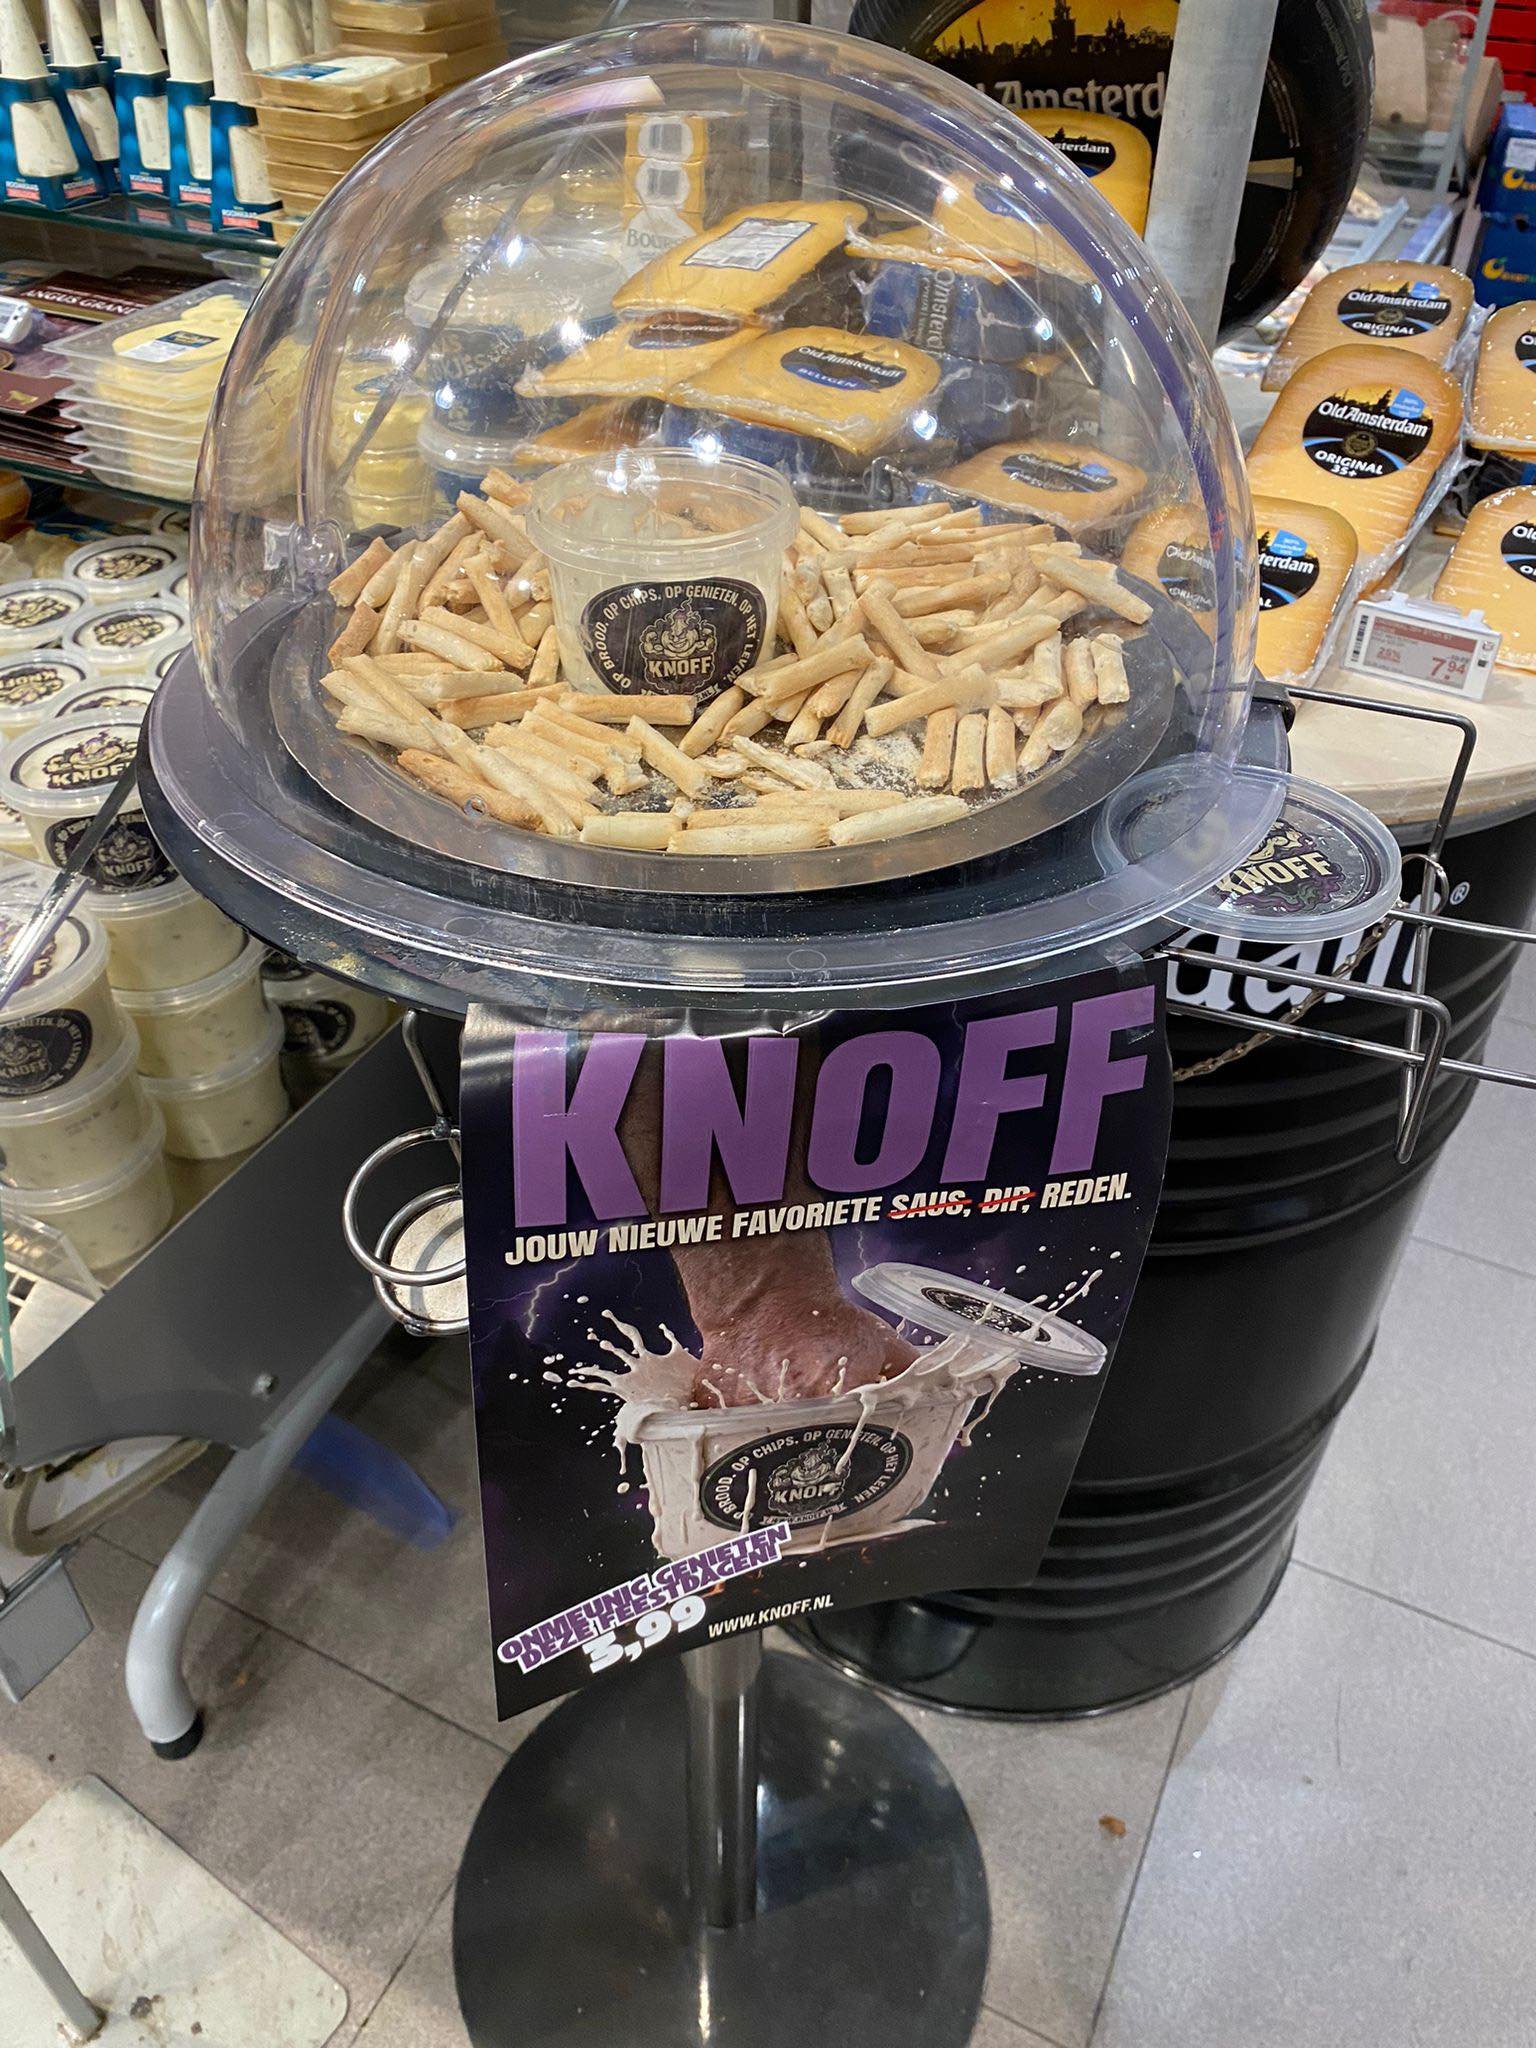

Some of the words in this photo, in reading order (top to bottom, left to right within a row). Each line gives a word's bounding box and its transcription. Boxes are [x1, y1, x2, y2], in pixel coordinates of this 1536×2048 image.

[994, 71, 1167, 119] Amsterd
[1053, 142, 1110, 154] sterdam
[1347, 291, 1372, 304] Old
[1371, 294, 1448, 310] Amsterdam
[1352, 321, 1415, 335] ORIGINAL
[1318, 401, 1347, 420] Old
[1344, 407, 1429, 438] Amsterdam
[1314, 450, 1384, 475] ORIGINAL
[1331, 464, 1358, 477] 35+
[619, 588, 662, 610] CHIPS.
[665, 585, 683, 599] OP
[685, 585, 739, 607] GENIETEN.
[602, 602, 619, 620] OP
[739, 598, 753, 615] OP
[745, 614, 758, 640] HET
[594, 620, 616, 671] BROOD.
[648, 656, 712, 679] KNOFF
[722, 643, 755, 683] LEVEN.
[612, 672, 632, 690] OP
[51, 762, 131, 786] KNOF
[1216, 850, 1335, 896] KNOFF
[513, 985, 1156, 1228] KNOFF
[505, 1229, 598, 1266] JOUW
[608, 1215, 724, 1253] NIEUWE
[732, 1196, 883, 1239] FAVORIETE
[890, 1190, 971, 1219] SAUS,
[1040, 1173, 1132, 1209] REDEN.
[752, 1435, 800, 1459] CHIPS.
[803, 1430, 822, 1442] OP
[879, 1441, 897, 1454] OP
[731, 1456, 750, 1472] OP
[884, 1453, 899, 1474] HET
[715, 1473, 737, 1515] BROOD.
[502, 1575, 650, 1661] ONMEUNIG
[655, 1524, 789, 1583] GENIETEN
[522, 1618, 594, 1670] DEZE
[599, 1542, 780, 1631] FEESTDAGEN!
[708, 1594, 834, 1639] WWW.KNOFF.NL
[582, 1595, 707, 1674] 3,99
